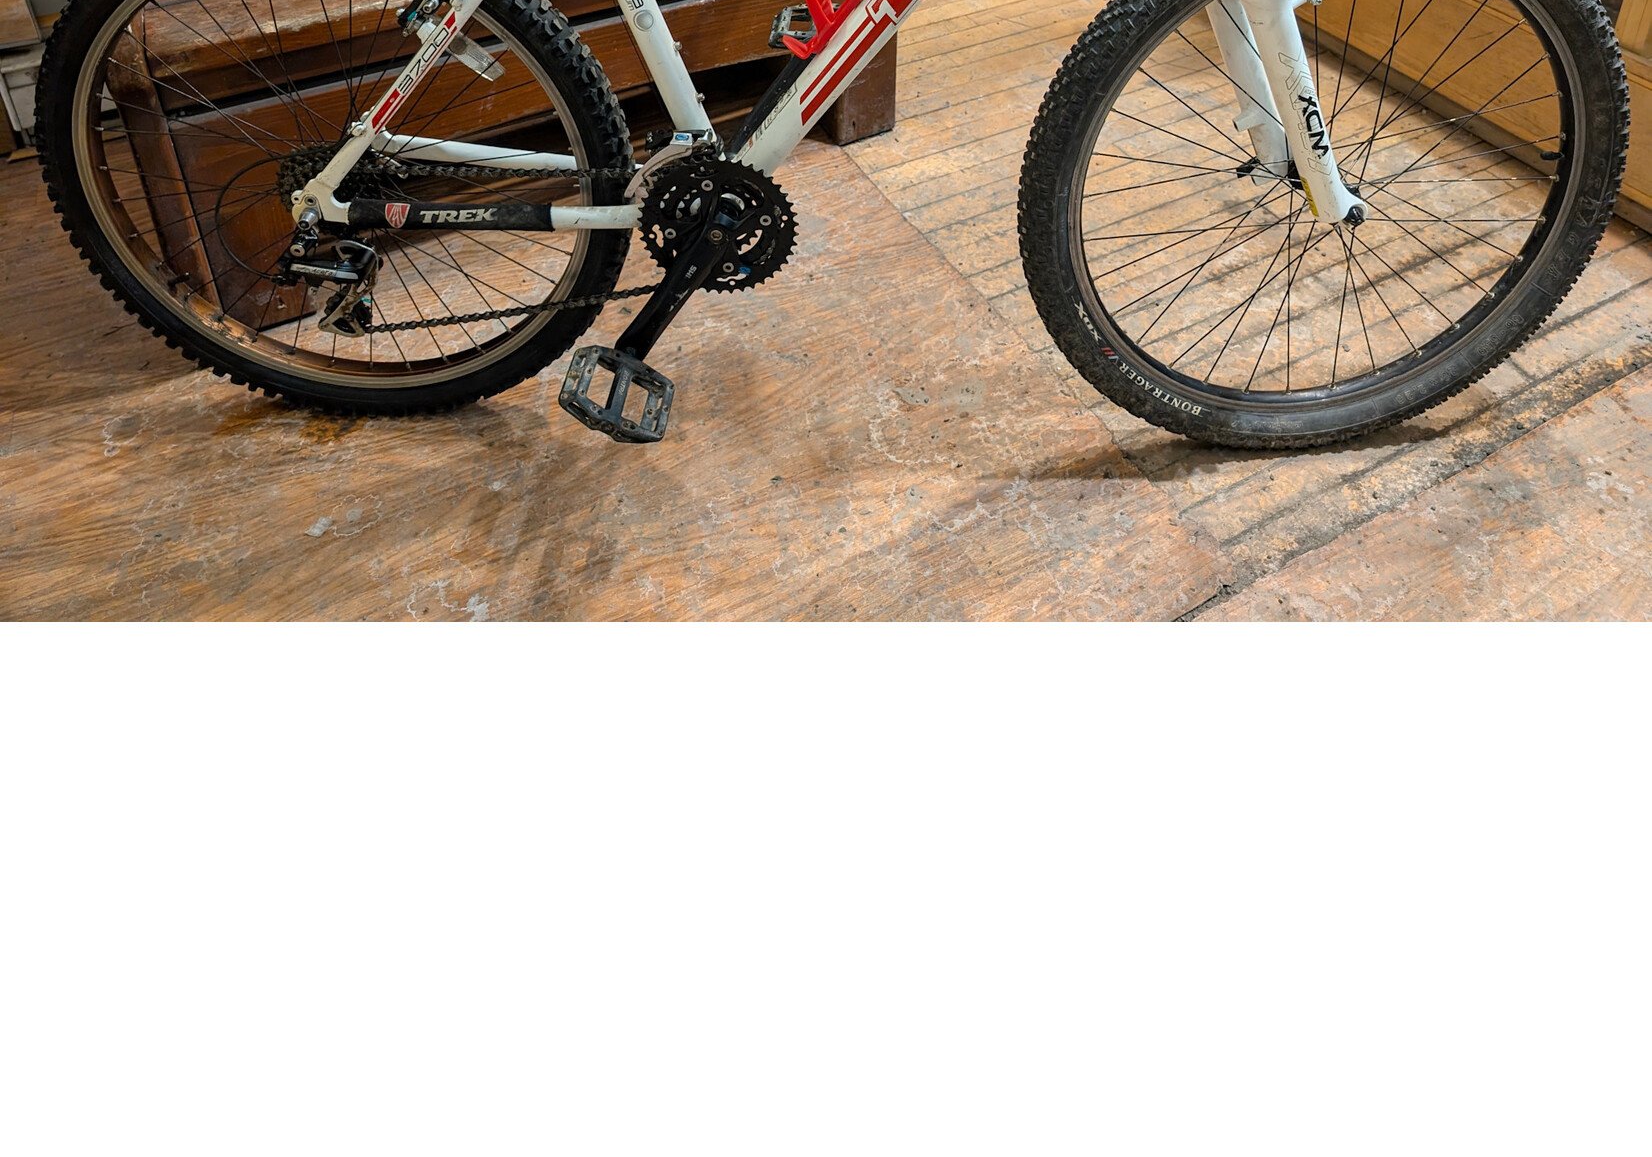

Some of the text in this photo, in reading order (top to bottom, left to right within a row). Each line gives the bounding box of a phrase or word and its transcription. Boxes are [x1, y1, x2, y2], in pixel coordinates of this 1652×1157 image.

[1298, 94, 1329, 160] XCM
[420, 207, 498, 224] TREK
[1119, 362, 1202, 416] BONTRAGER
